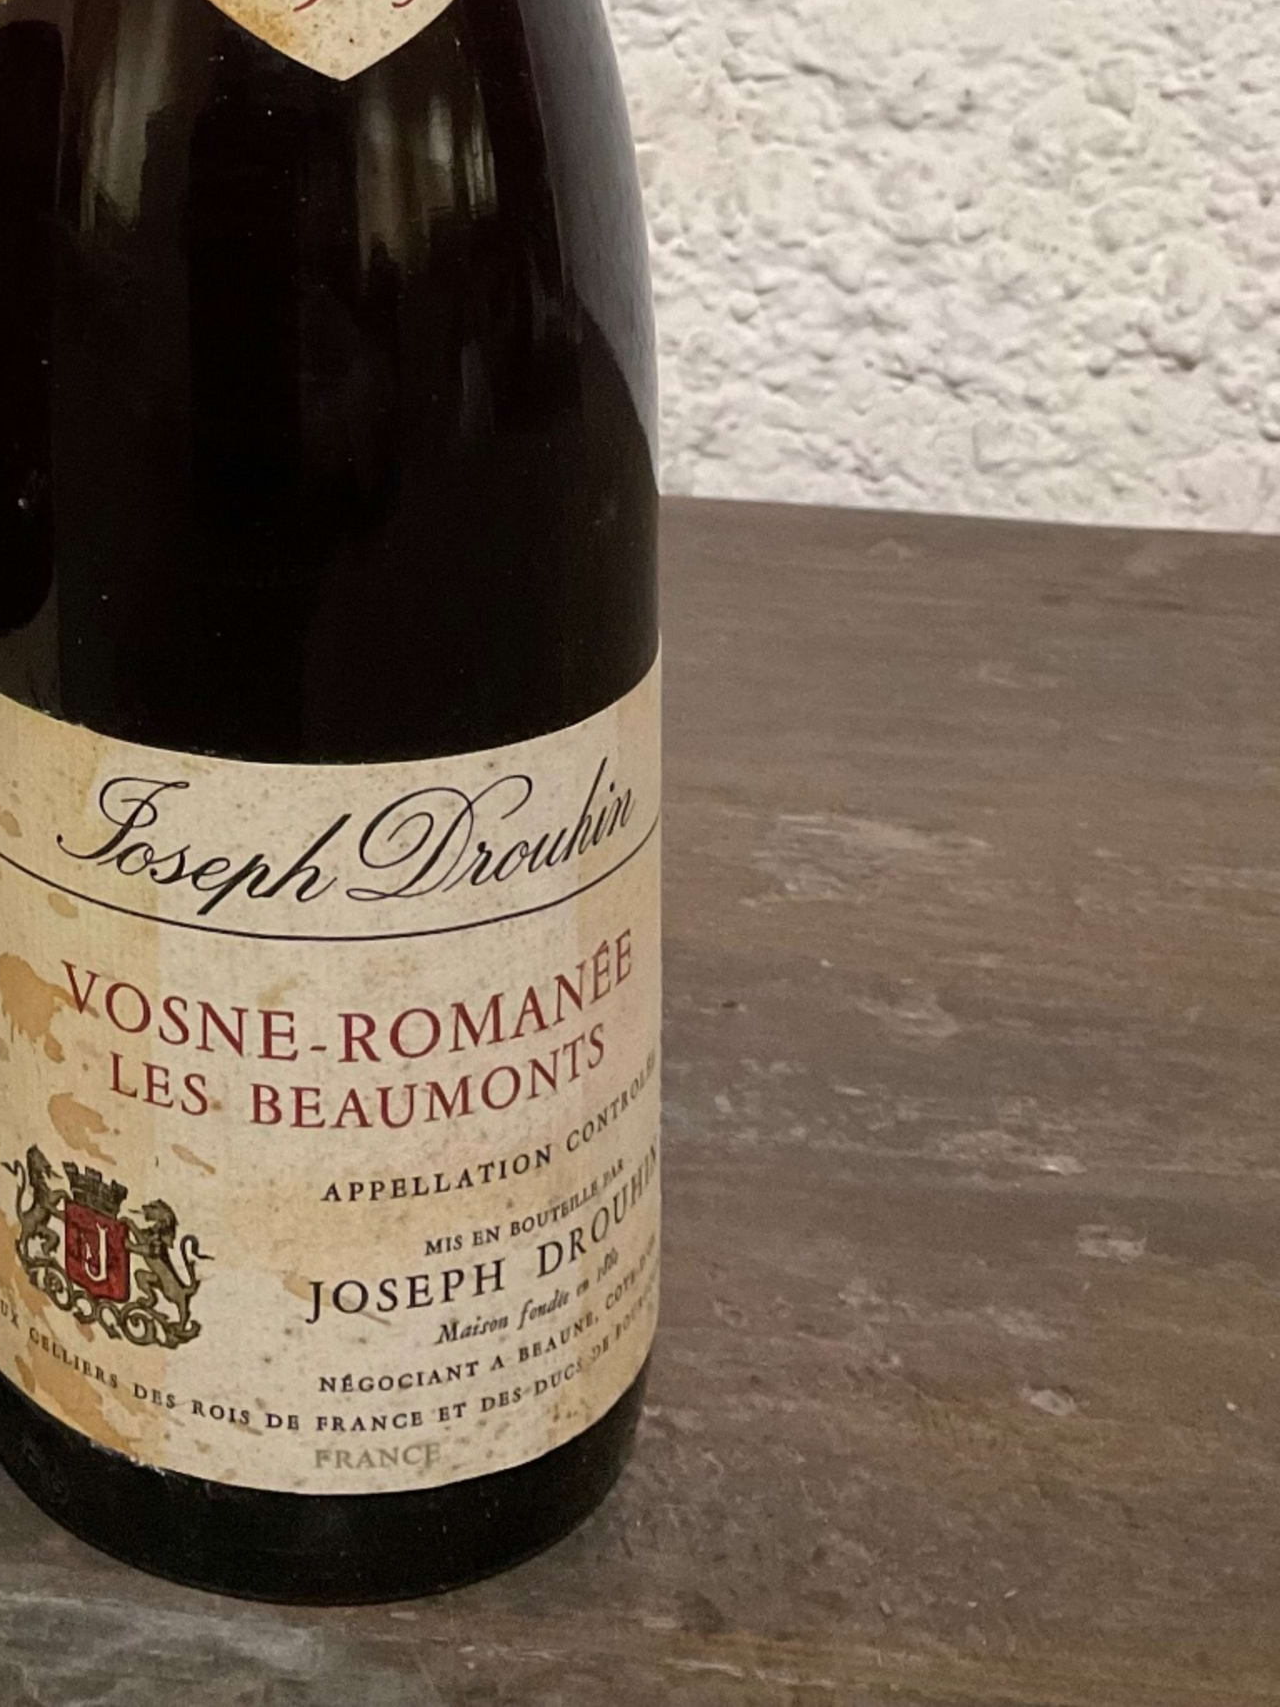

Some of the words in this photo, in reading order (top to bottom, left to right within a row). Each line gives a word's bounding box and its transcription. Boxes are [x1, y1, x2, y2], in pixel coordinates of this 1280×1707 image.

[56, 776, 352, 916] Joseph
[346, 756, 636, 903] Drouhin
[60, 927, 633, 1064] VOSNE-ROMANÉE
[109, 1051, 209, 1117] LES
[250, 1022, 605, 1130] BEAUMONTS
[320, 1143, 552, 1202] APPELLATION
[424, 1234, 462, 1256] MIS
[472, 1225, 500, 1246] EN
[510, 1178, 598, 1236] BOUTEILLE
[305, 1257, 506, 1324] JOSEPH
[434, 1315, 509, 1345] Maison
[28, 1327, 118, 1390] CELLIERS
[134, 1382, 177, 1410] DES
[192, 1399, 251, 1426] ROIS
[266, 1413, 300, 1431] DE
[316, 1411, 424, 1432] FRANCE
[438, 1402, 467, 1422] ET
[481, 1386, 522, 1413] DES
[319, 1360, 480, 1394] NÉGOCIANT
[489, 1354, 505, 1371] A
[519, 1309, 600, 1364] BEAUNE,
[314, 1443, 442, 1469] FRANCE
